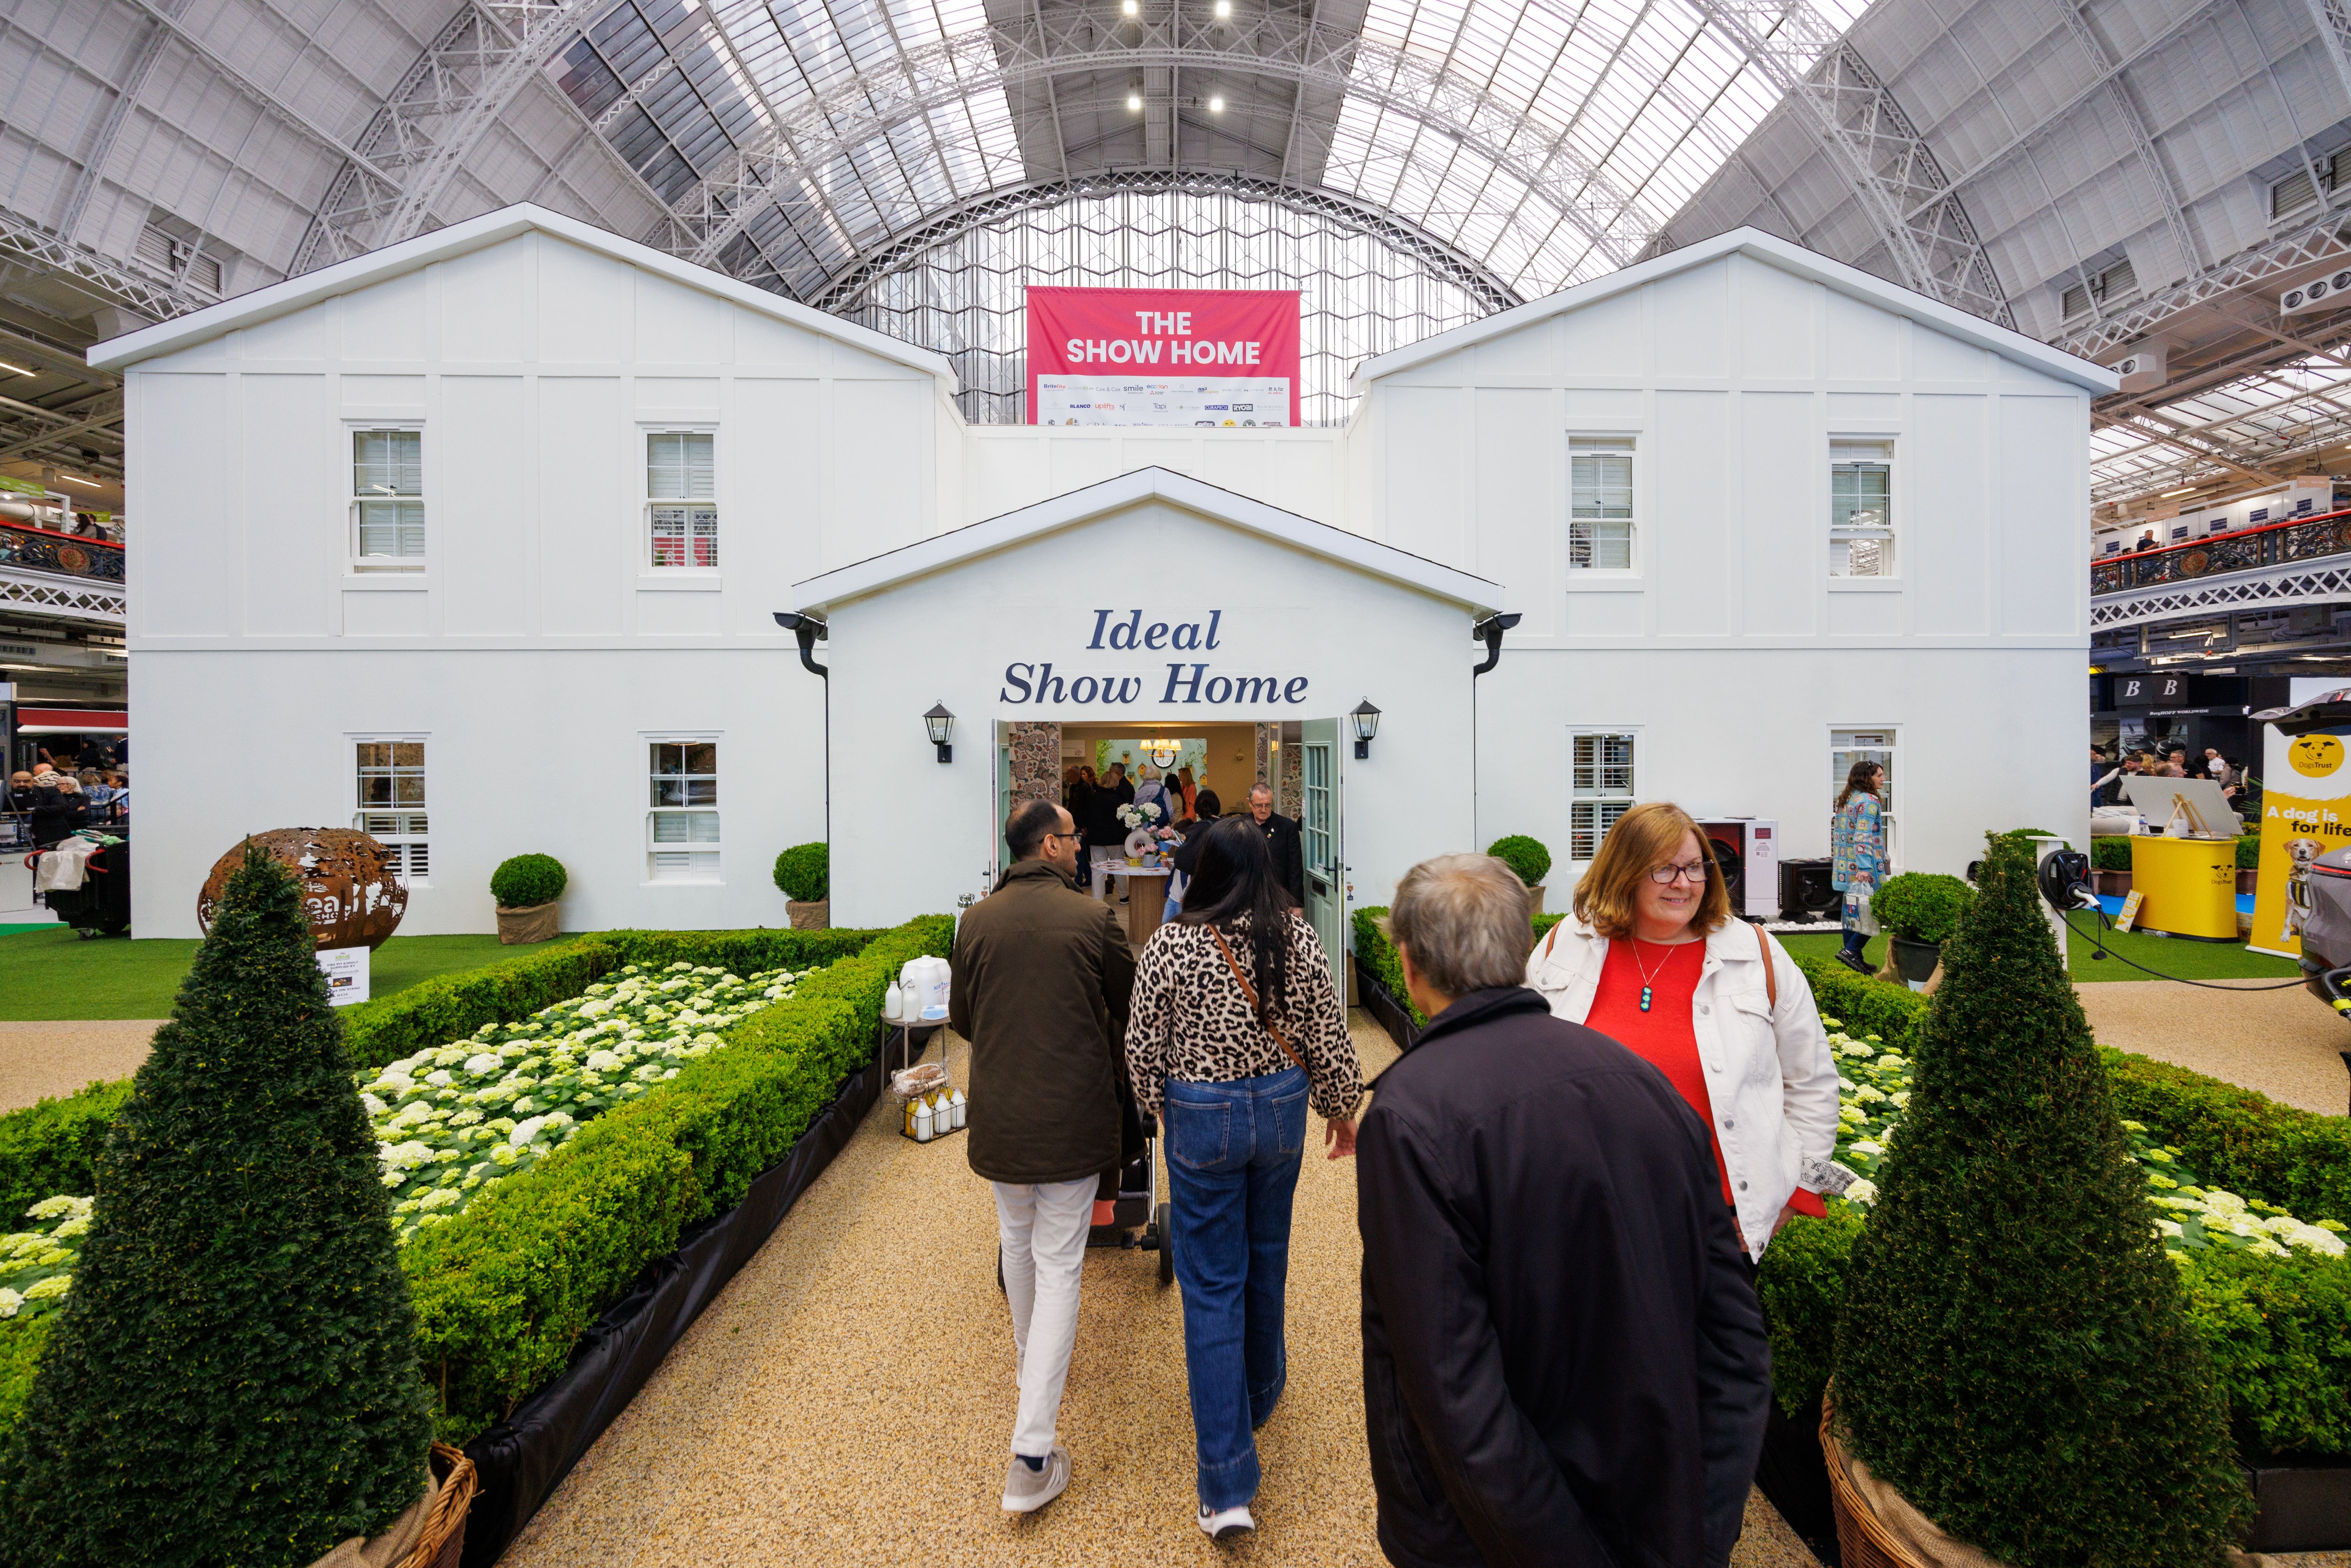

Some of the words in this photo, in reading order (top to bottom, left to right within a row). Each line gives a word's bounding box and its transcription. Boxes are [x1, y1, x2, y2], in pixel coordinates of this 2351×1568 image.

[1136, 311, 1191, 335] THE
[1066, 339, 1163, 365] SHOW
[1171, 340, 1260, 365] HOME
[1086, 609, 1222, 650] Ideal
[1000, 662, 1141, 703] Show
[1158, 663, 1309, 703] Home
[2124, 680, 2140, 697] B
[2162, 679, 2177, 695] B
[2266, 805, 2280, 818] A
[2282, 807, 2319, 823] dog
[2322, 808, 2338, 822] is
[2291, 820, 2319, 834] for
[2324, 823, 2351, 836] life
